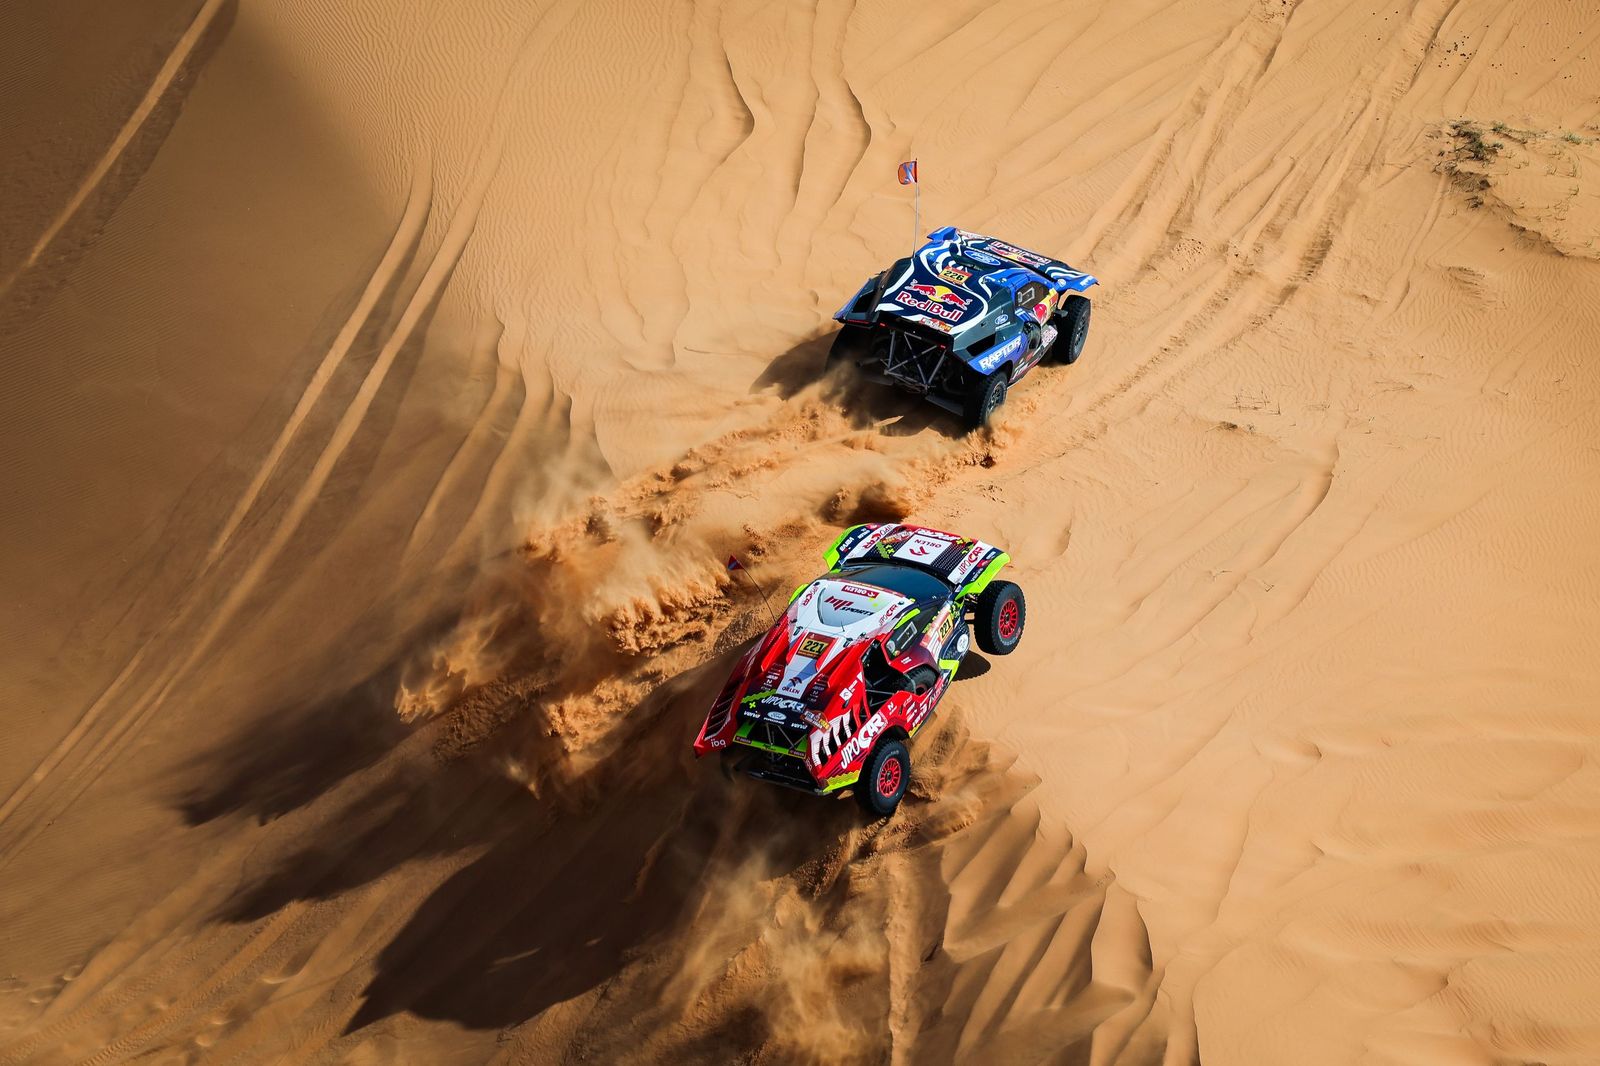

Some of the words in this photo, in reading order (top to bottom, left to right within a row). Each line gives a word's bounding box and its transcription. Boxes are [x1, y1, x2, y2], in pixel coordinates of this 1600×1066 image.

[943, 270, 965, 281] 226
[895, 291, 931, 311] Red
[927, 302, 964, 322] Bull
[979, 336, 1021, 371] RAPTOR
[914, 539, 942, 548] ORLEN
[844, 585, 867, 594] ORLEN
[939, 619, 952, 639] 221
[803, 641, 826, 654] 221
[781, 686, 800, 695] ORLEN
[760, 695, 804, 711] JIPOCAR
[840, 712, 888, 769] JIPOCAR
